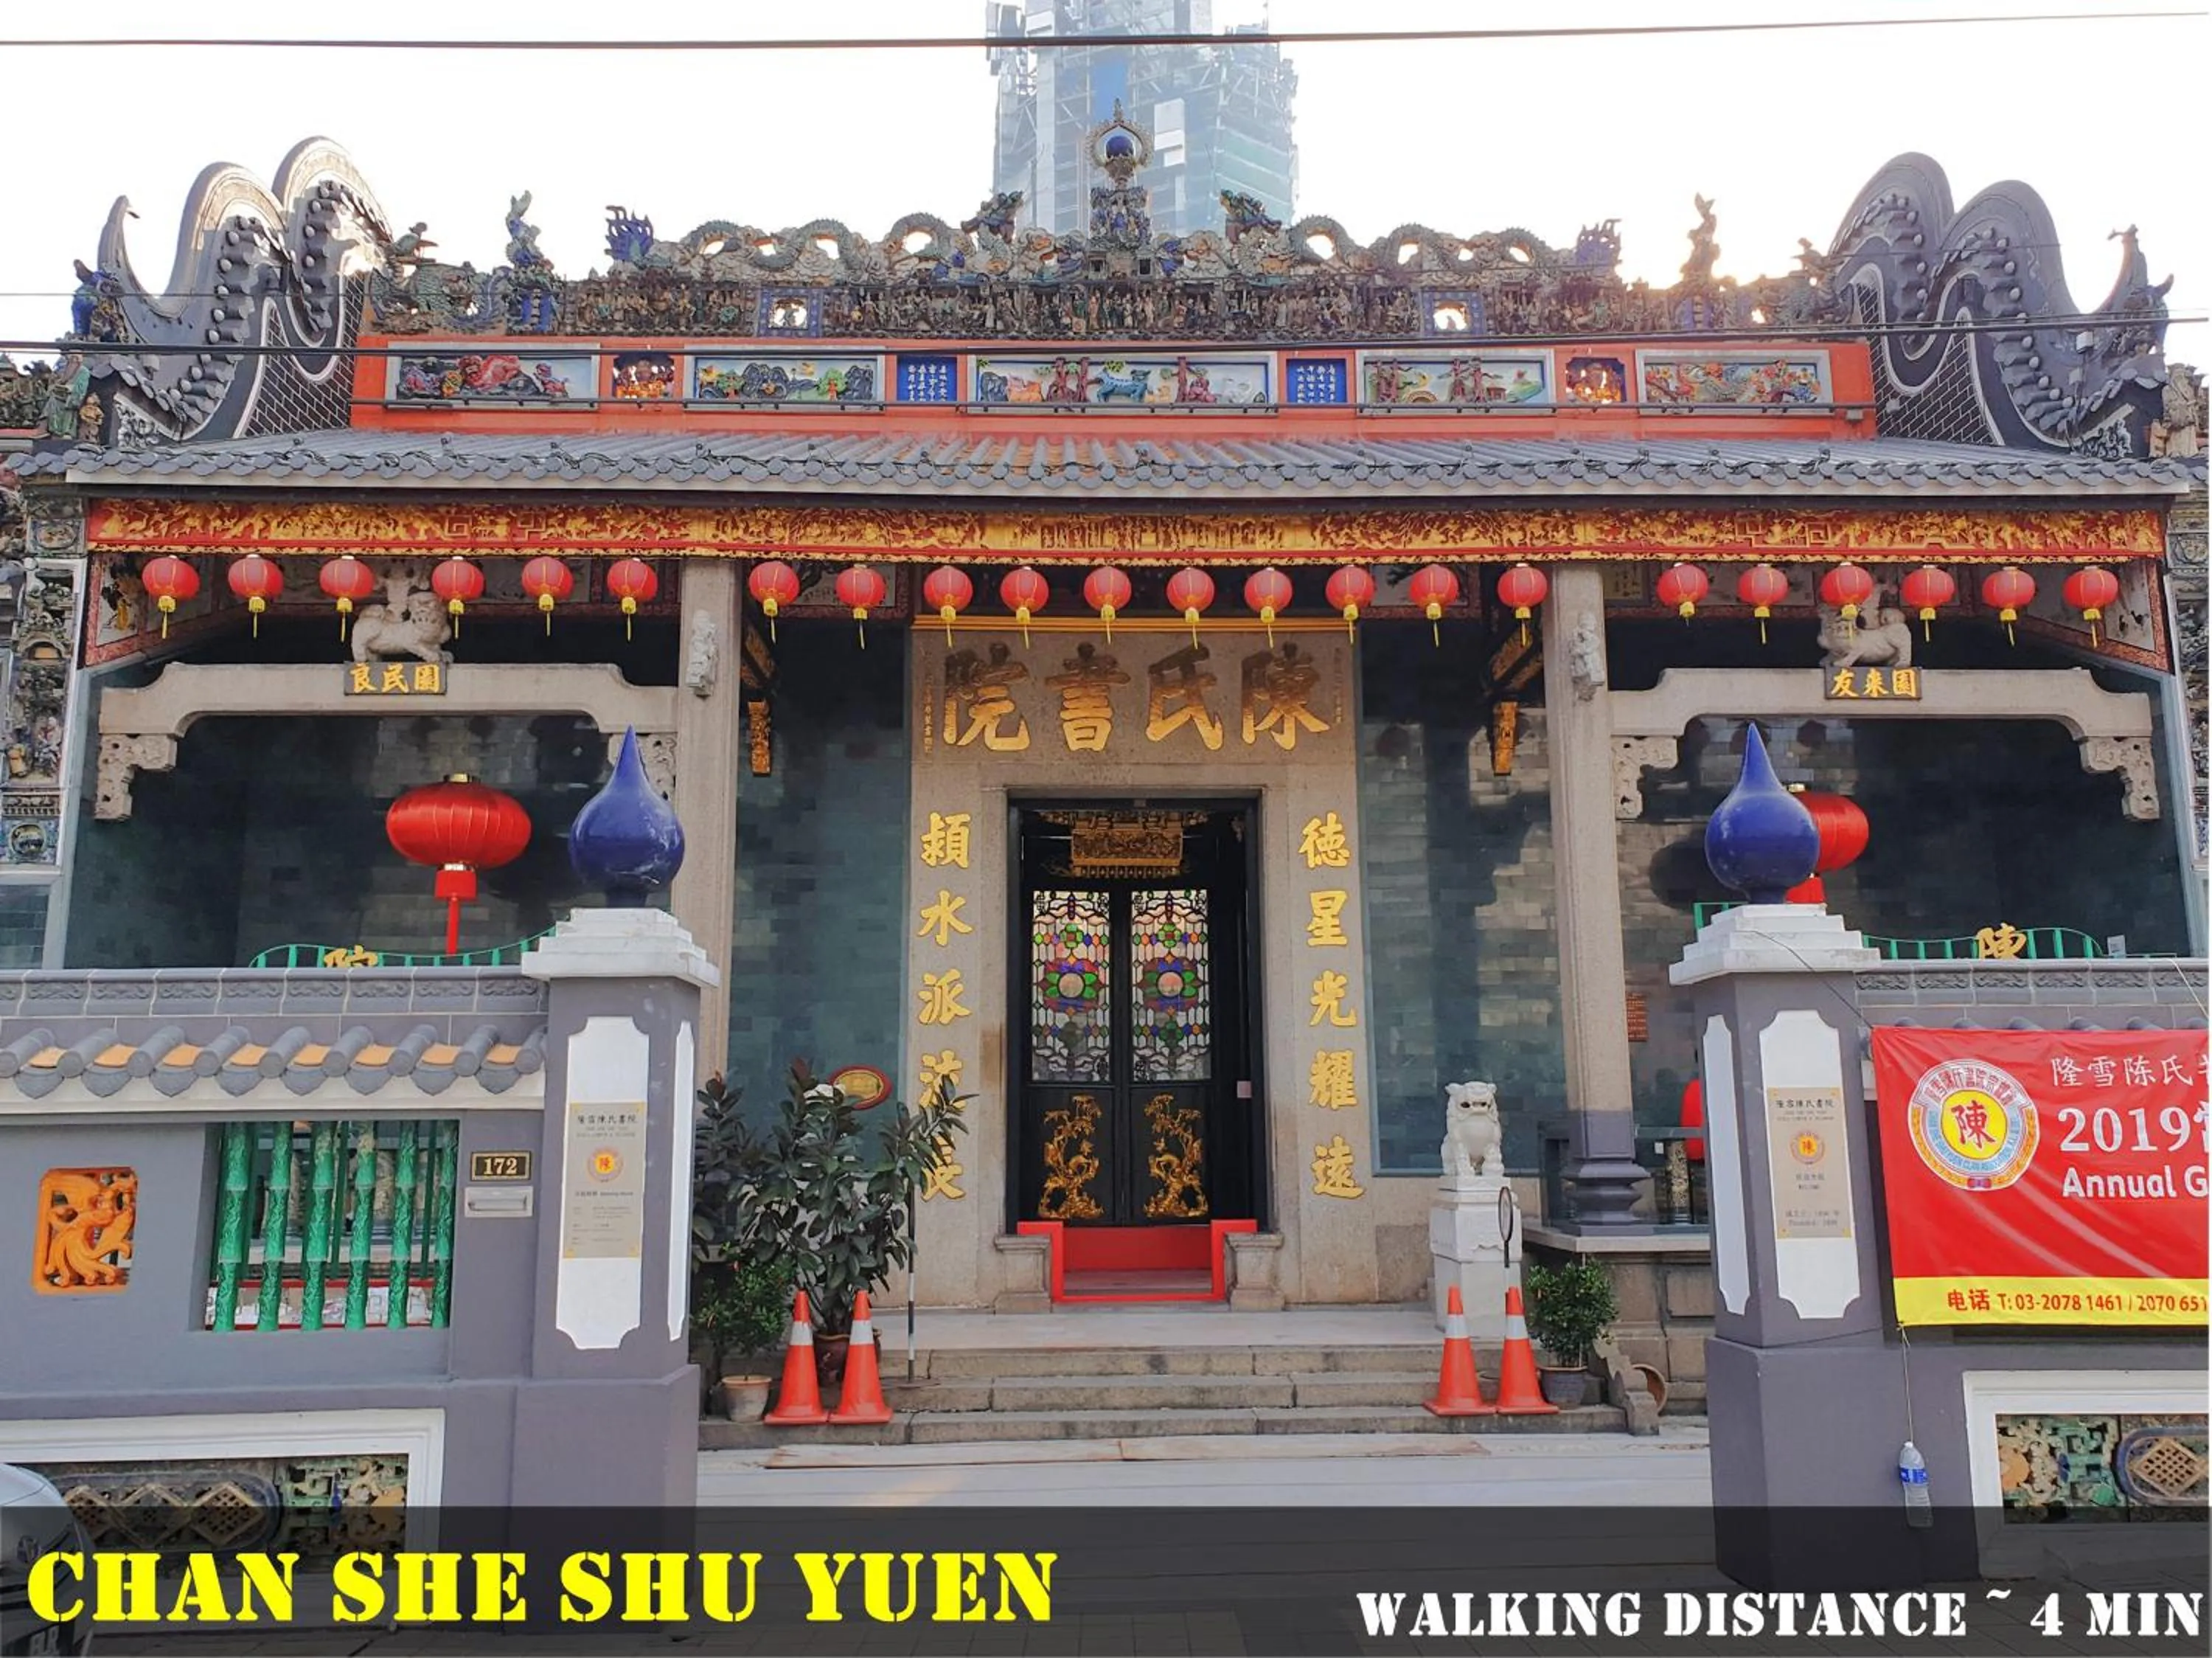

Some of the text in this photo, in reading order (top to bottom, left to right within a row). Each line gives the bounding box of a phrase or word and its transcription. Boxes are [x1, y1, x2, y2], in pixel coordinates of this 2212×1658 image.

[1950, 1100, 1996, 1149] 陳
[483, 1157, 518, 1175] 172
[2062, 1165, 2177, 1199] Annual
[1947, 1289, 1990, 1311] 电话
[2015, 1293, 2081, 1311] 03-2078
[2086, 1294, 2123, 1311] 1461
[2137, 1294, 2175, 1311] 2070
